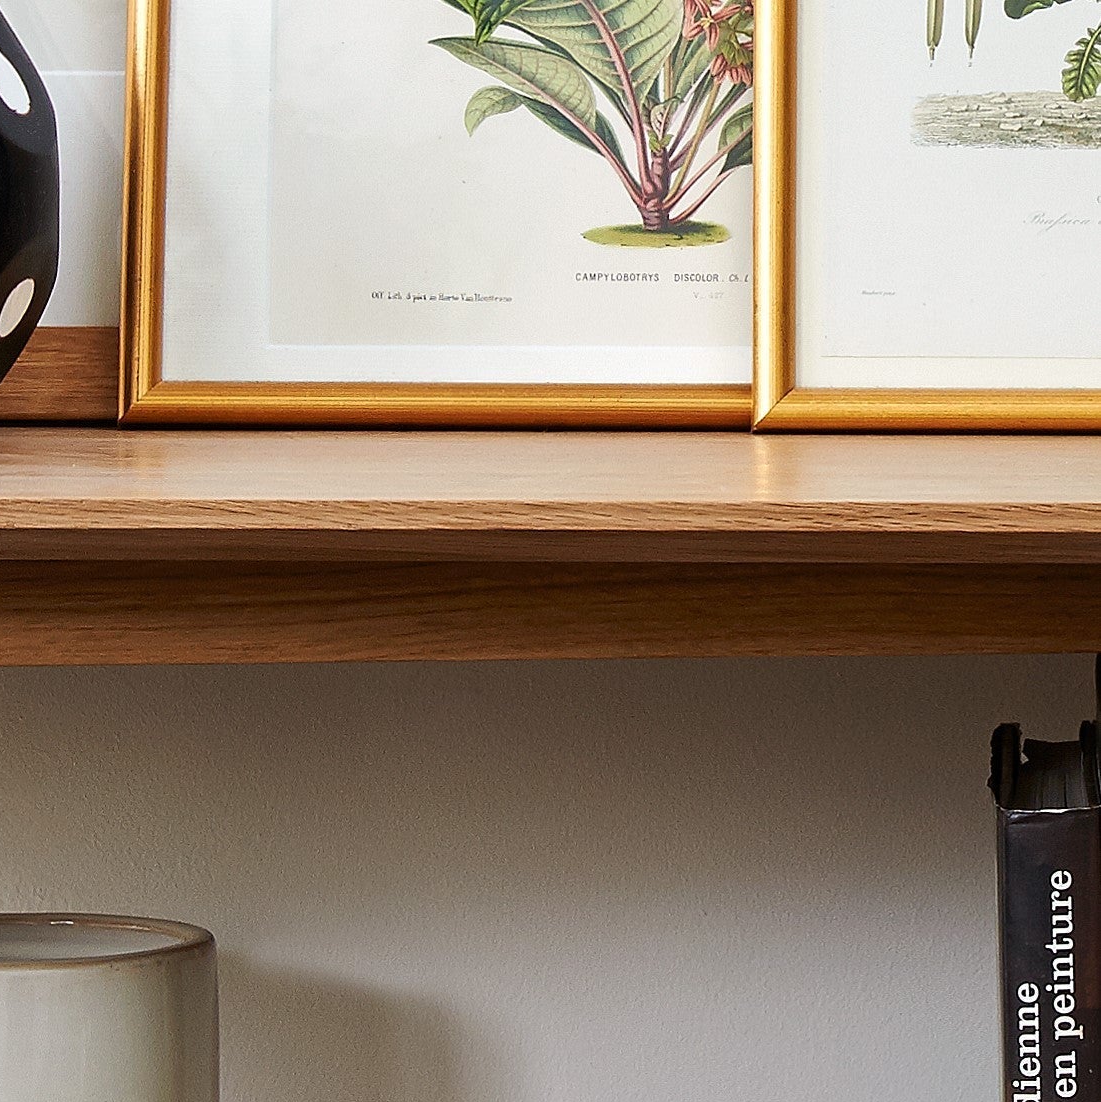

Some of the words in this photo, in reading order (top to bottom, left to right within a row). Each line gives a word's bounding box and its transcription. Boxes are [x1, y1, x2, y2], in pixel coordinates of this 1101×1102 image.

[575, 272, 660, 282] CAMPYLOBOTRYS
[1045, 870, 1084, 1041] peinture
[1055, 1050, 1077, 1098] en
